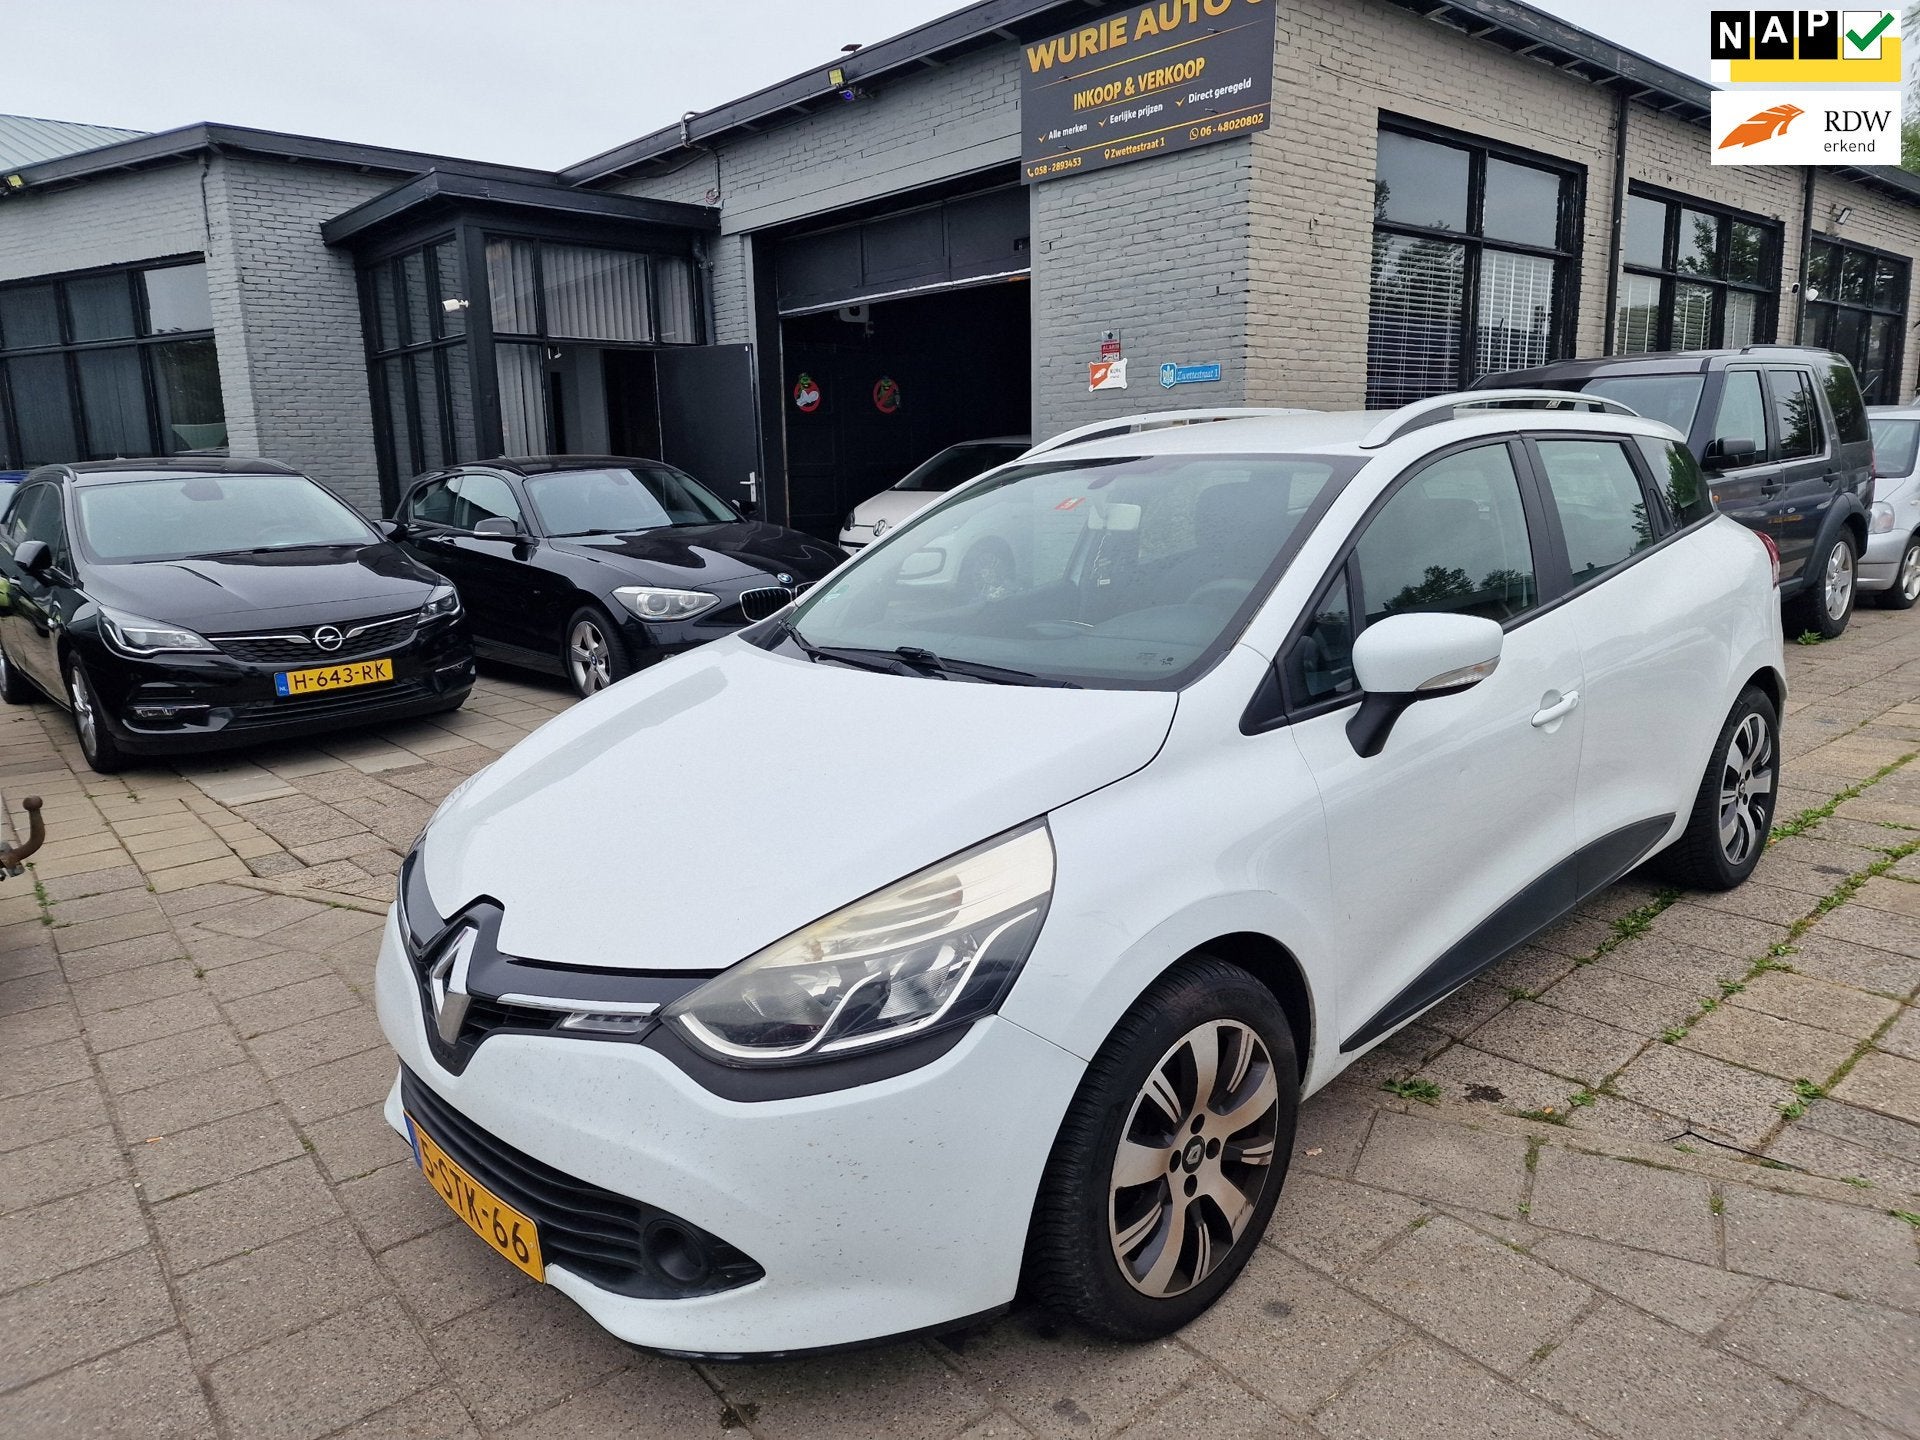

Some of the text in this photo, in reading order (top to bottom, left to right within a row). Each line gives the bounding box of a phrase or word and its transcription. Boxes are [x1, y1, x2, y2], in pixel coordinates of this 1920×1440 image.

[1026, 0, 1233, 74] WURIE AUTO
[1073, 57, 1206, 111] INKOOP & VERKOOP
[1188, 77, 1252, 105] Direct geregeld
[1109, 102, 1163, 126] Eerlijke prijzen
[1048, 122, 1088, 142] Alle merken
[1110, 137, 1165, 159] Zwettestraat 1
[294, 662, 387, 691] H-643-RK
